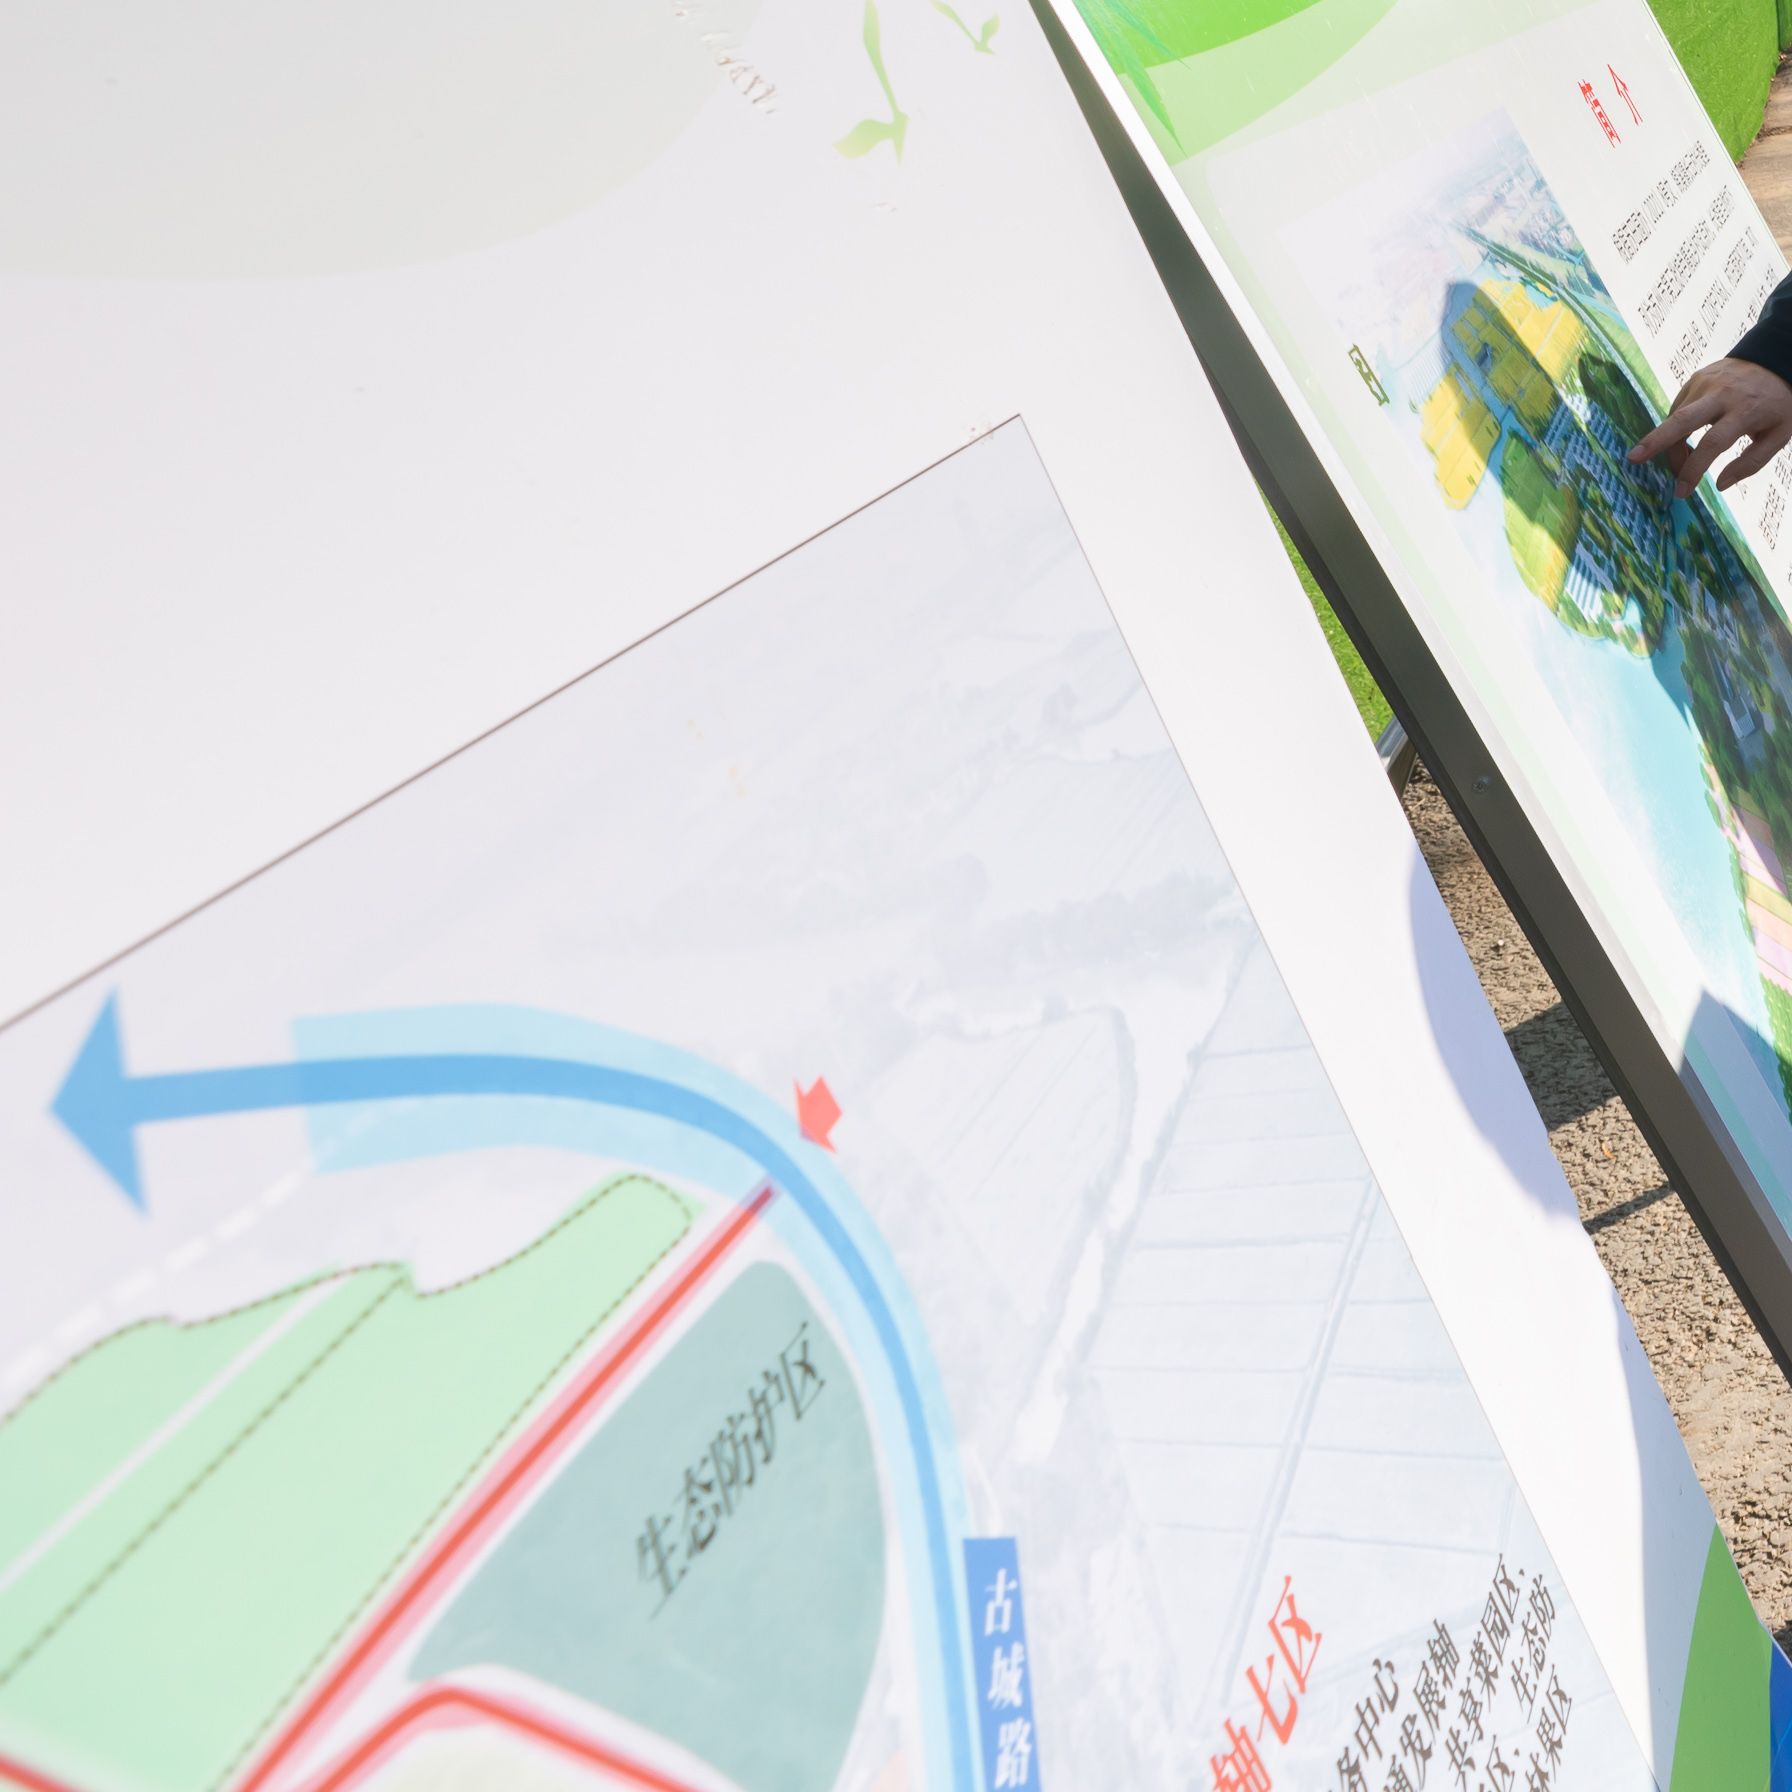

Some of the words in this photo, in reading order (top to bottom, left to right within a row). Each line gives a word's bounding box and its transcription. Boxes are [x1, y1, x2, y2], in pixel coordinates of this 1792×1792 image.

[636, 1322, 826, 1620] 生态防护区
[984, 1568, 1033, 1790] 古城路
